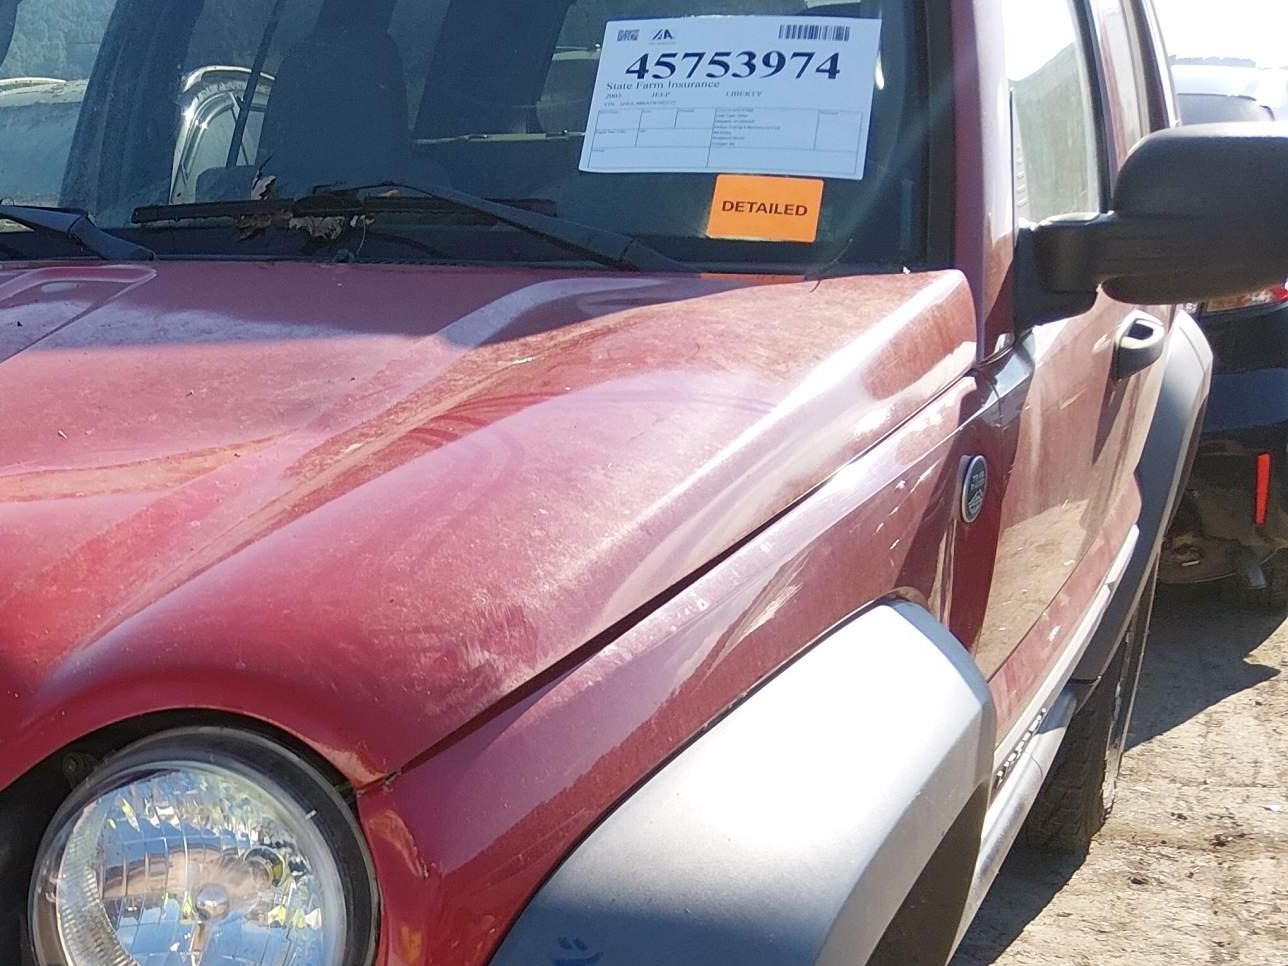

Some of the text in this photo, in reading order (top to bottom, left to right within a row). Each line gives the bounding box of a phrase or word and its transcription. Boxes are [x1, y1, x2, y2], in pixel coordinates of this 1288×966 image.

[624, 50, 841, 79] 45753974
[606, 80, 720, 91] State Farm Insurance
[722, 200, 808, 217] DETAILED
